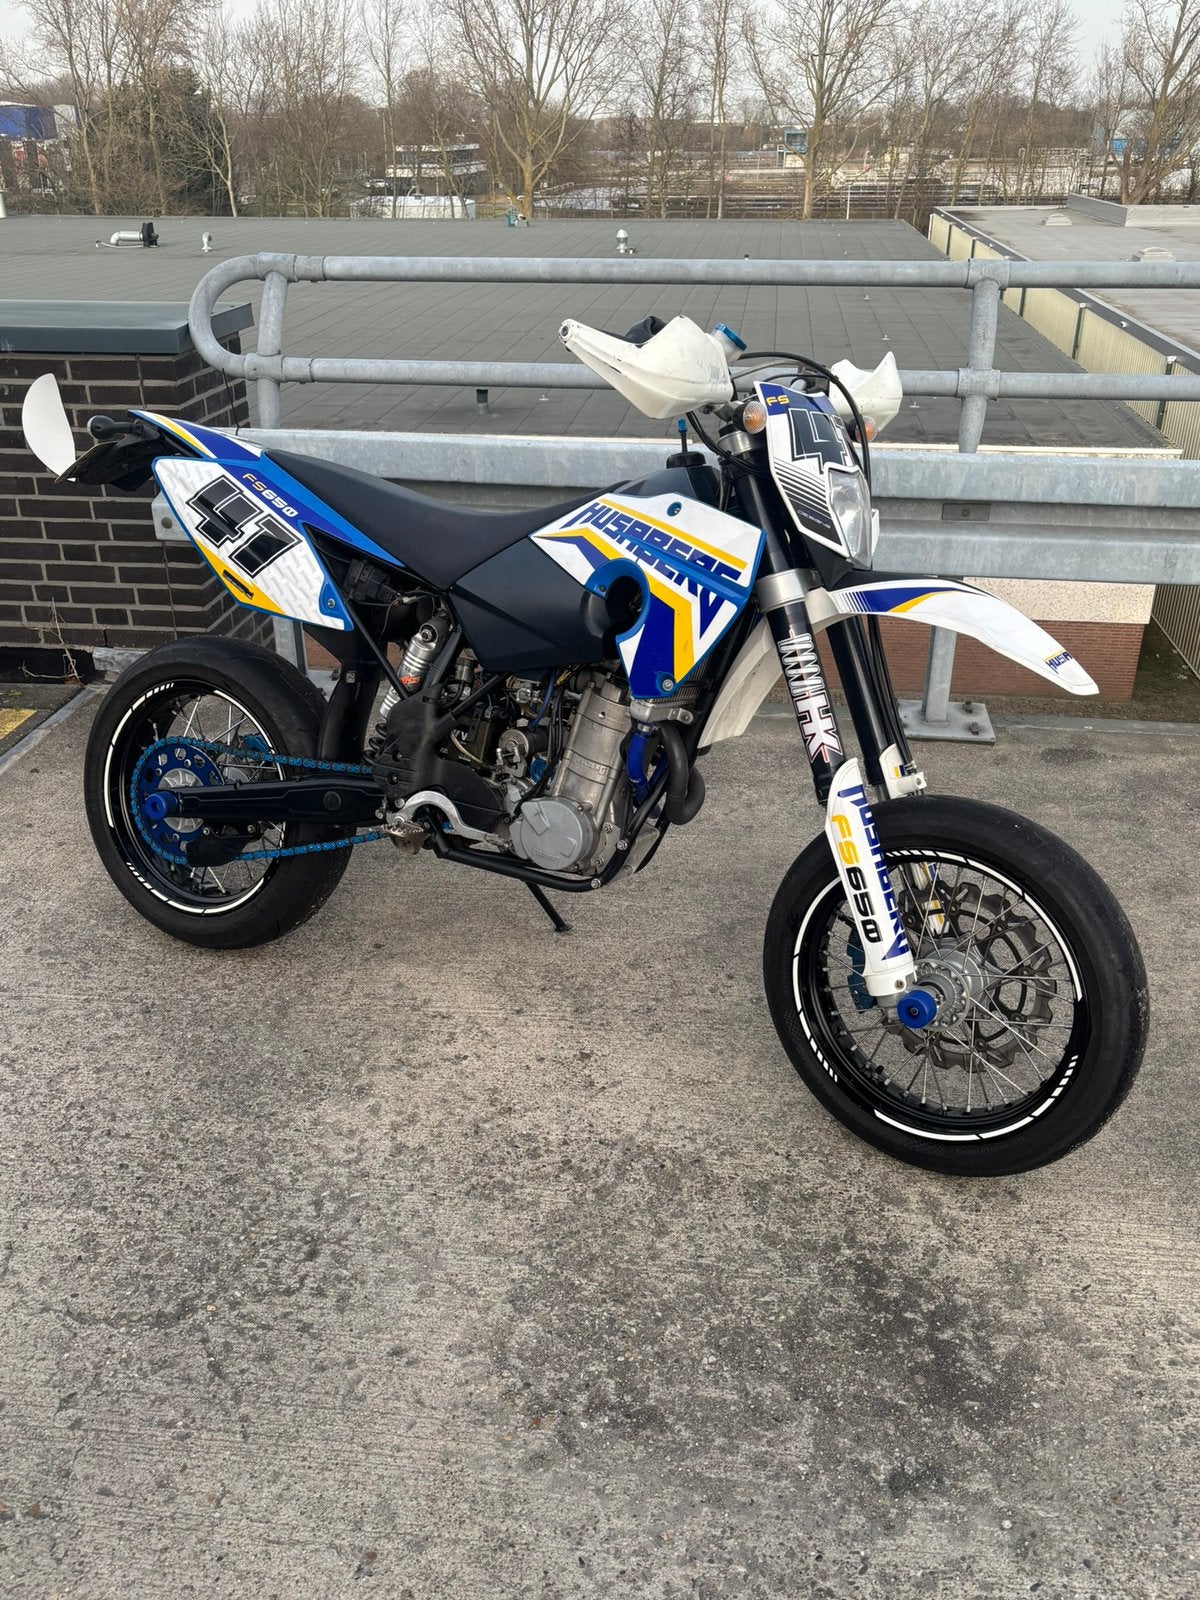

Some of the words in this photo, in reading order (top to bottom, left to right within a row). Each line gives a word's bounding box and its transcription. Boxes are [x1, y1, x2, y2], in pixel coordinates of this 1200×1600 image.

[766, 394, 790, 407] FS
[242, 473, 299, 518] FS650
[832, 814, 884, 944] FS650
